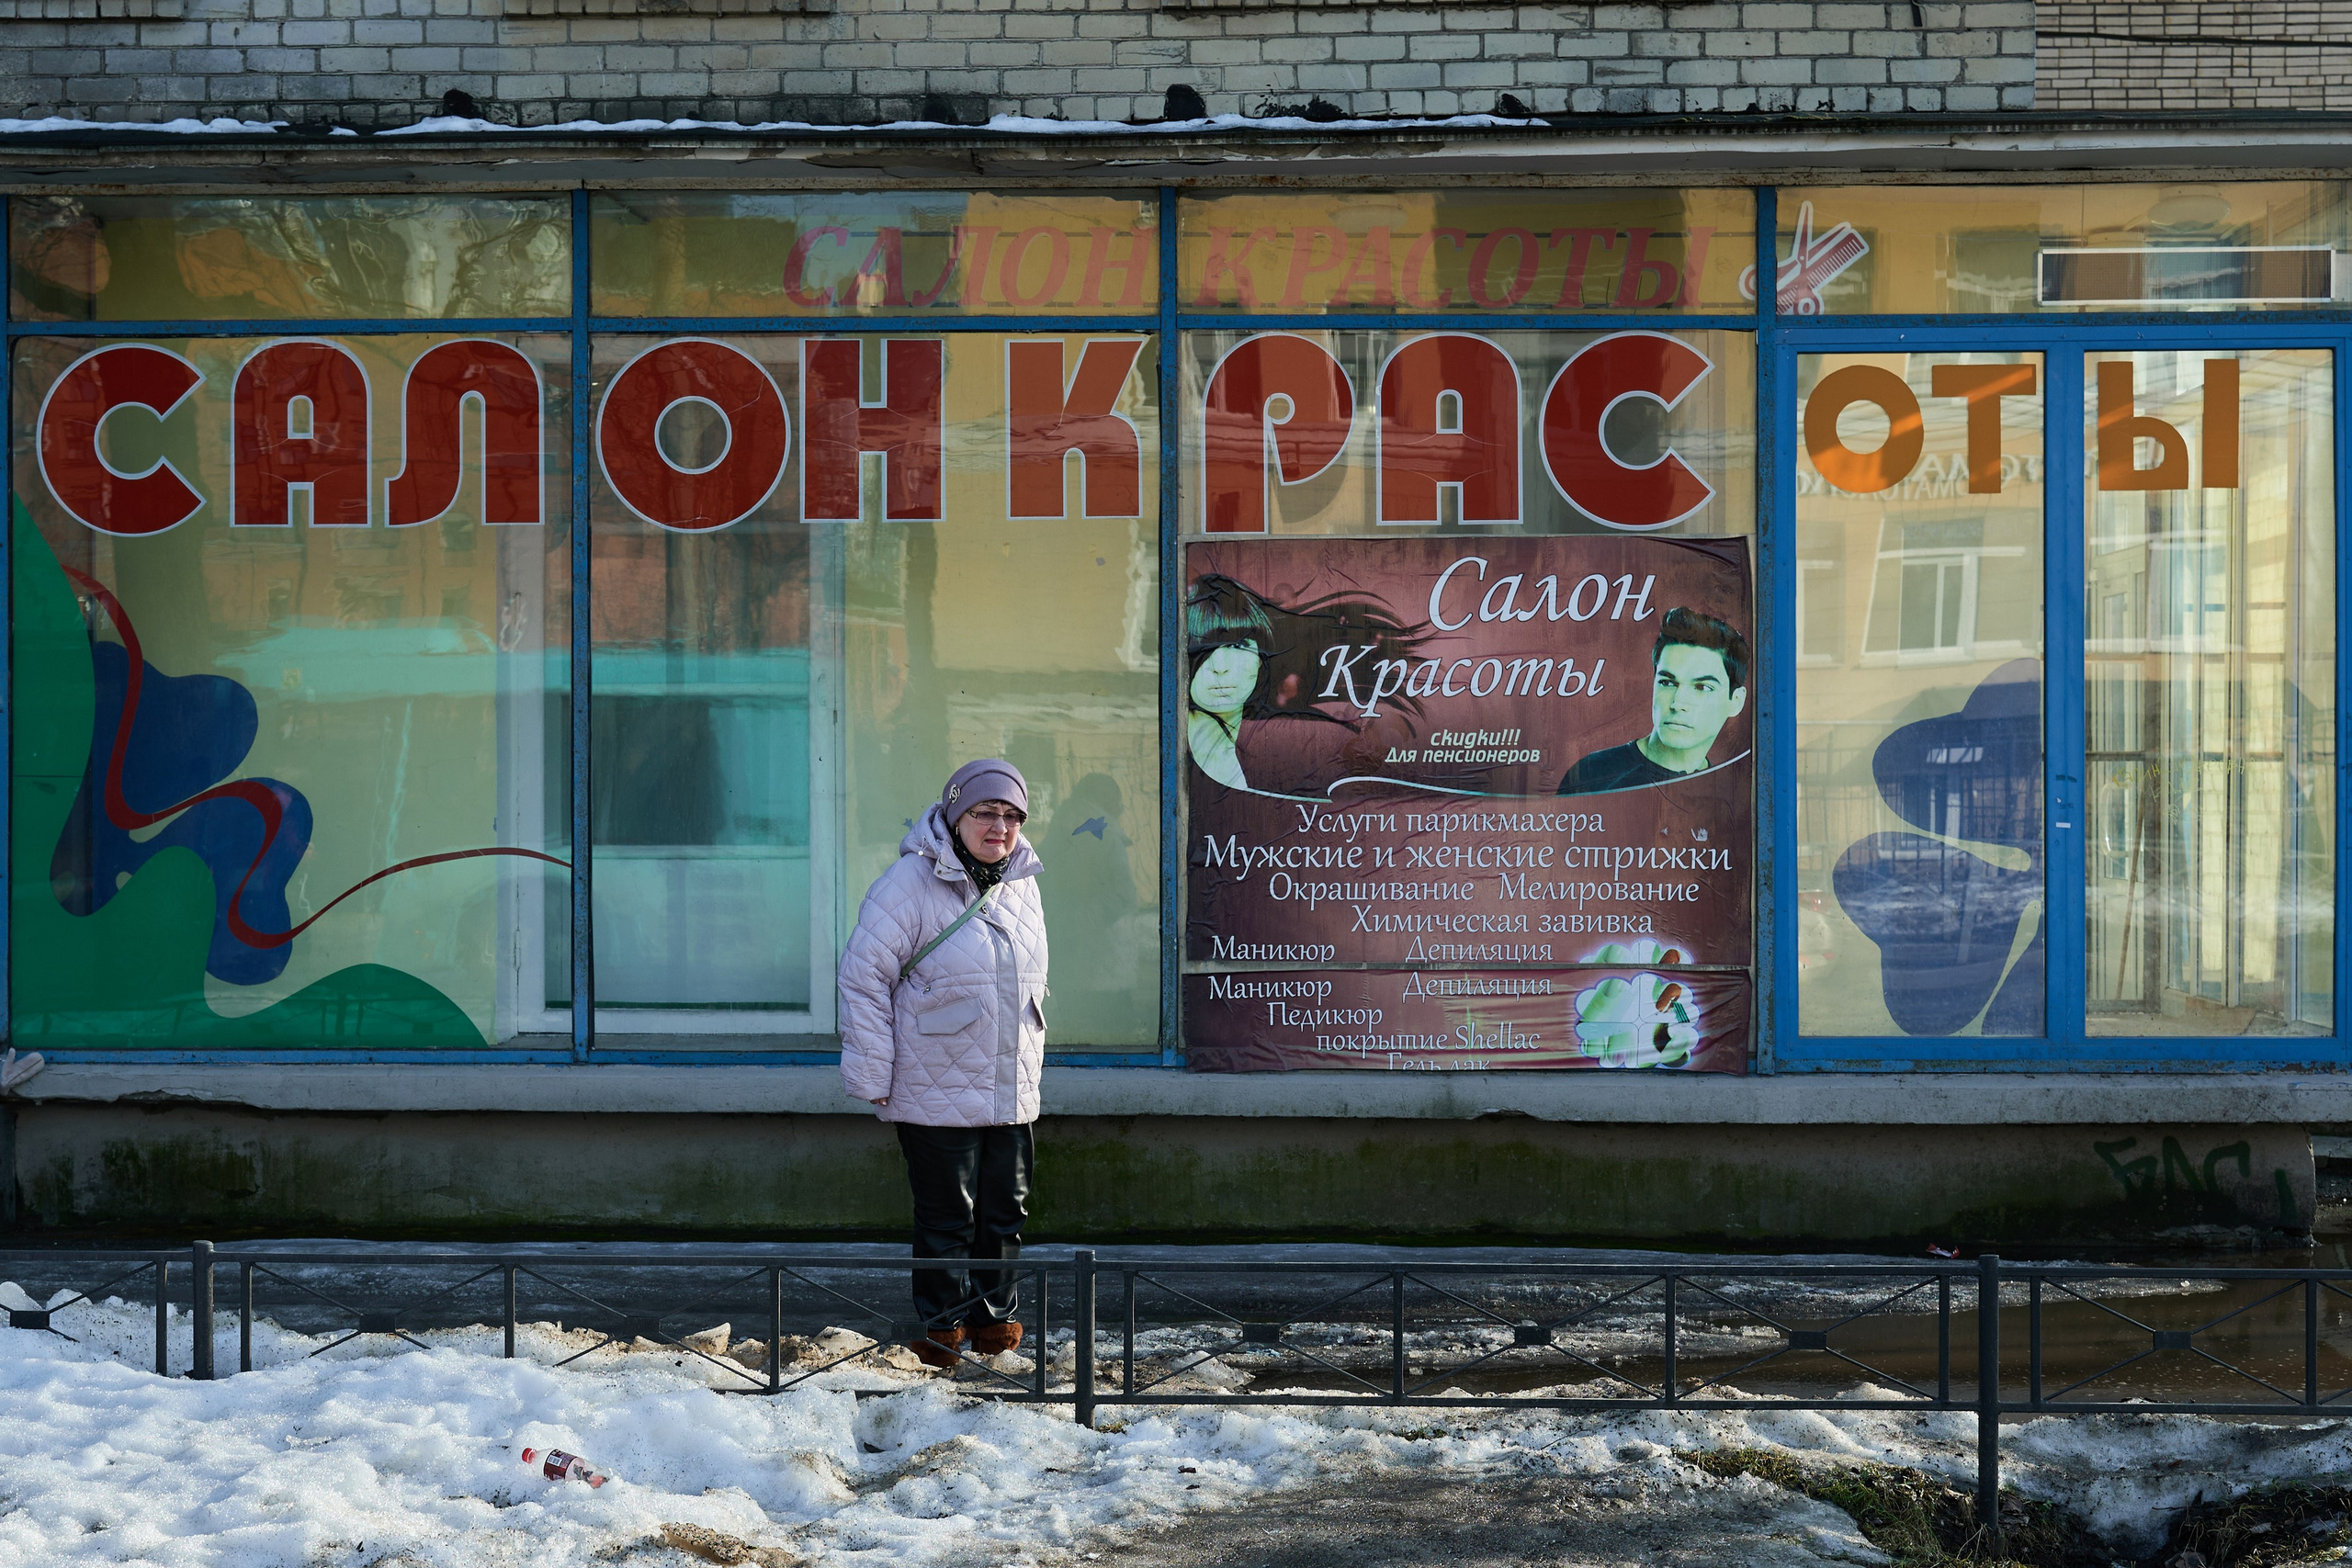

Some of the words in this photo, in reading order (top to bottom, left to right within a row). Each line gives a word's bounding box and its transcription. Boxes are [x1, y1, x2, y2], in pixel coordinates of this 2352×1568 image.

[784, 225, 1155, 310] САЛОН
[1193, 225, 1718, 310] КРАСОТЫ
[36, 336, 946, 537] САЛОН
[1429, 557, 1657, 632] Салон
[1317, 643, 1606, 718] Красоты
[1385, 747, 1418, 763] Для
[1422, 749, 1541, 764] пенсионеров
[1430, 729, 1521, 749] скидки!!!
[1295, 804, 1397, 844] Услуги
[1405, 810, 1605, 844] парикмахера
[1204, 833, 1363, 880] Мужские
[1374, 843, 1397, 869] и
[1406, 842, 1555, 870] женские
[1564, 843, 1734, 880] стрижки
[1269, 873, 1476, 909] Окрашивание
[1498, 872, 1701, 908] Мелирование
[1351, 905, 1531, 934] Химическая
[1538, 910, 1655, 934] завивка
[1211, 936, 1336, 963] Маникюр
[1405, 936, 1554, 964] Депиляция
[1208, 975, 1333, 1004] Маникюр
[1402, 971, 1553, 1002] Депиляция
[1268, 1001, 1384, 1032] Педикюр
[1316, 1031, 1449, 1053] покрытие
[1454, 1021, 1541, 1051] Shellac
